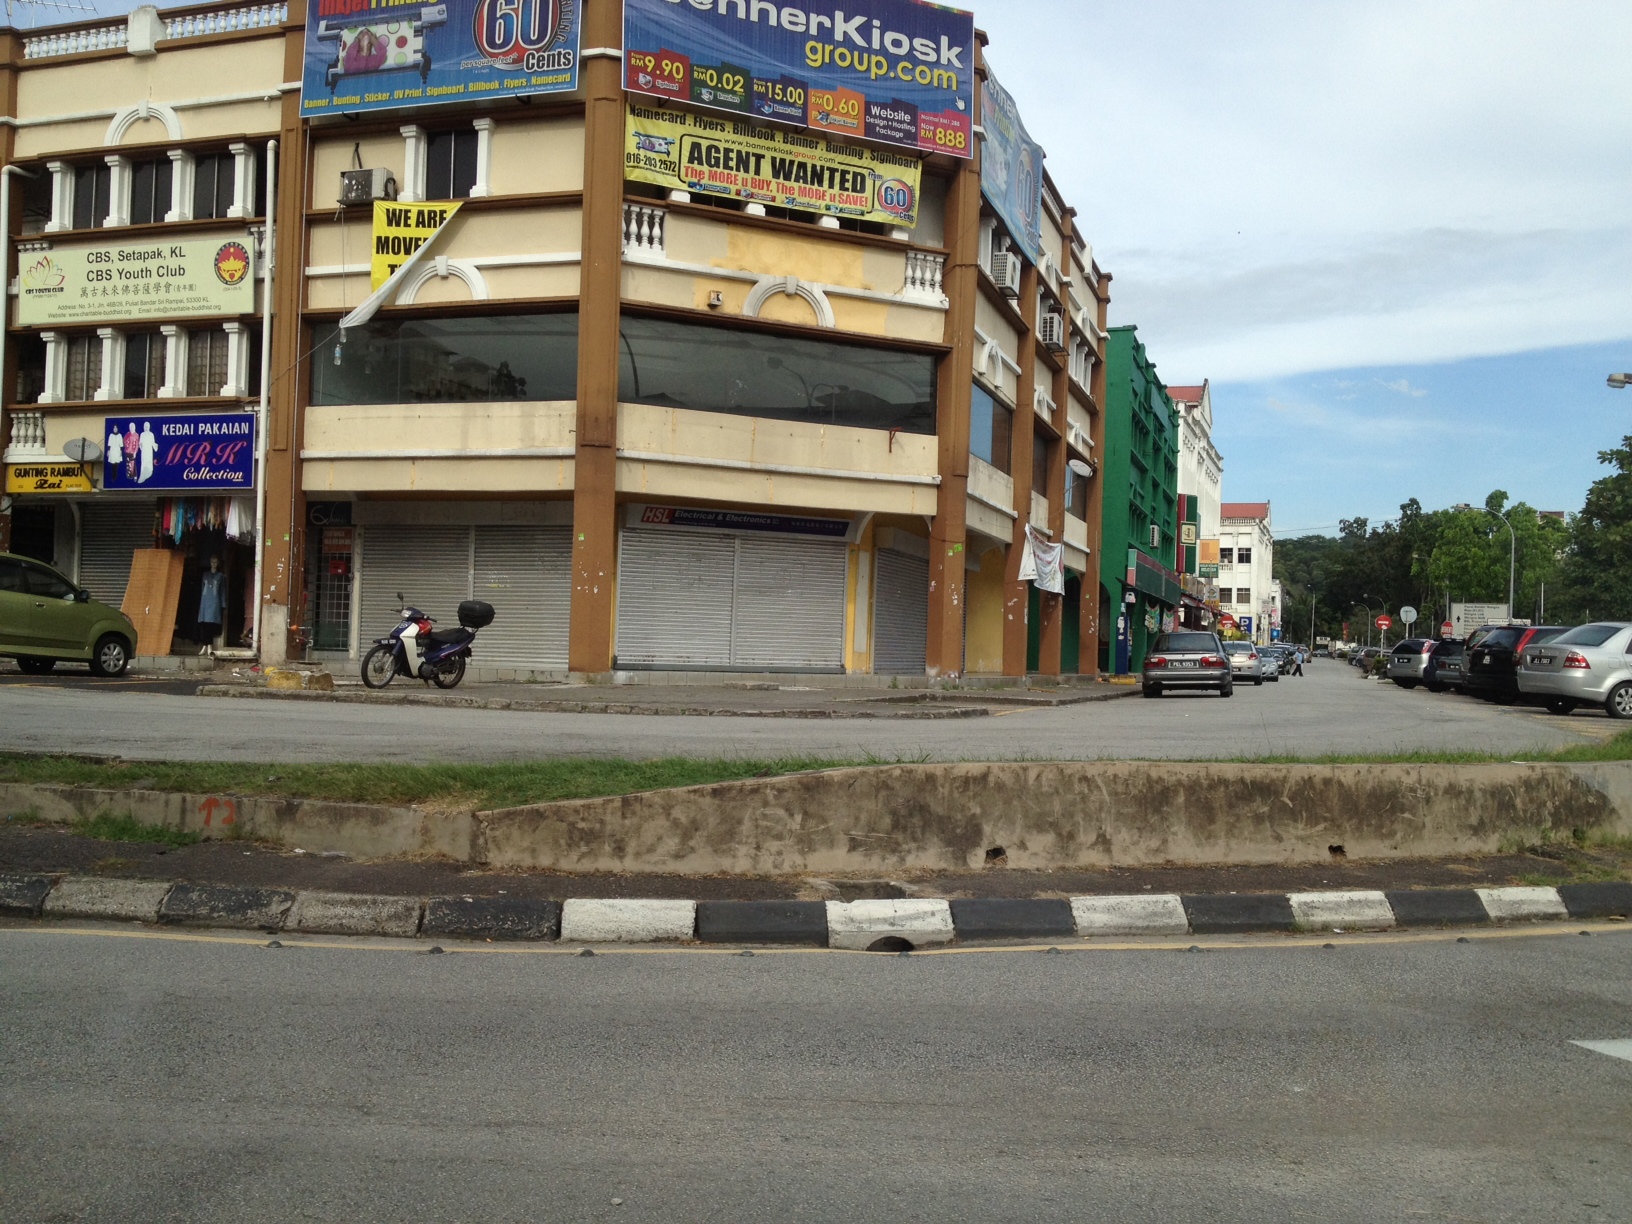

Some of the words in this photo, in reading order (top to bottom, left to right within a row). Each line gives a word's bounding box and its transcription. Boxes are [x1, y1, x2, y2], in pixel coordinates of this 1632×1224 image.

[483, 0, 554, 53] 60
[524, 49, 574, 73] Cents
[631, 58, 645, 68] RM
[644, 56, 684, 80] 9.90
[804, 39, 958, 91] group.com
[304, 98, 330, 109] Banner
[333, 94, 361, 105] Bunting
[364, 92, 391, 103] Sticker
[394, 90, 404, 100] UV
[404, 88, 422, 98] Print
[426, 83, 465, 96] Signboard
[468, 80, 500, 92] Billbook
[503, 78, 527, 89] Flyers
[531, 73, 571, 85] Namecard
[693, 71, 707, 81] RM
[706, 69, 745, 93] 0.02
[753, 85, 766, 94] RM
[766, 82, 804, 105] 15.00
[811, 96, 824, 105] RM
[822, 94, 859, 117] 0.60
[870, 104, 911, 122] Website
[865, 115, 887, 126] Design
[892, 121, 916, 133] Hosting
[921, 114, 939, 122] Normal
[921, 122, 935, 131] Now
[629, 103, 686, 126] Namecard
[693, 115, 726, 133] Flyers
[782, 133, 820, 151] Banner
[825, 141, 864, 160] Bunting
[869, 149, 919, 170] Signboard
[875, 126, 904, 138] Package
[920, 129, 934, 139] RM
[935, 127, 966, 149] 888
[626, 152, 658, 169] 016-203
[657, 158, 677, 173] 2572
[687, 141, 766, 177] AGENT
[770, 155, 866, 194] WANTED
[684, 164, 706, 180] The
[708, 169, 739, 186] MORE
[775, 180, 796, 195] The
[797, 184, 827, 202] MORE
[838, 192, 869, 208] SAVE!
[883, 185, 908, 209] 60
[385, 208, 412, 228] WE
[415, 209, 447, 228] ARE
[86, 251, 114, 264] CBS,
[117, 248, 166, 263] Setapak,
[170, 246, 186, 258] KL
[375, 235, 429, 256] MOVE
[86, 269, 113, 282] CBS
[117, 267, 152, 280] Youth
[156, 264, 186, 278] Club
[387, 263, 403, 277] T
[162, 423, 194, 436] KEDAI
[198, 422, 249, 435] PAKAIAN
[14, 467, 49, 478] GUNTING
[50, 466, 83, 478] RAMBUT
[183, 466, 244, 481] Collection
[643, 507, 670, 523] HSL
[674, 510, 715, 520] Electrical
[725, 514, 771, 524] Electronics
